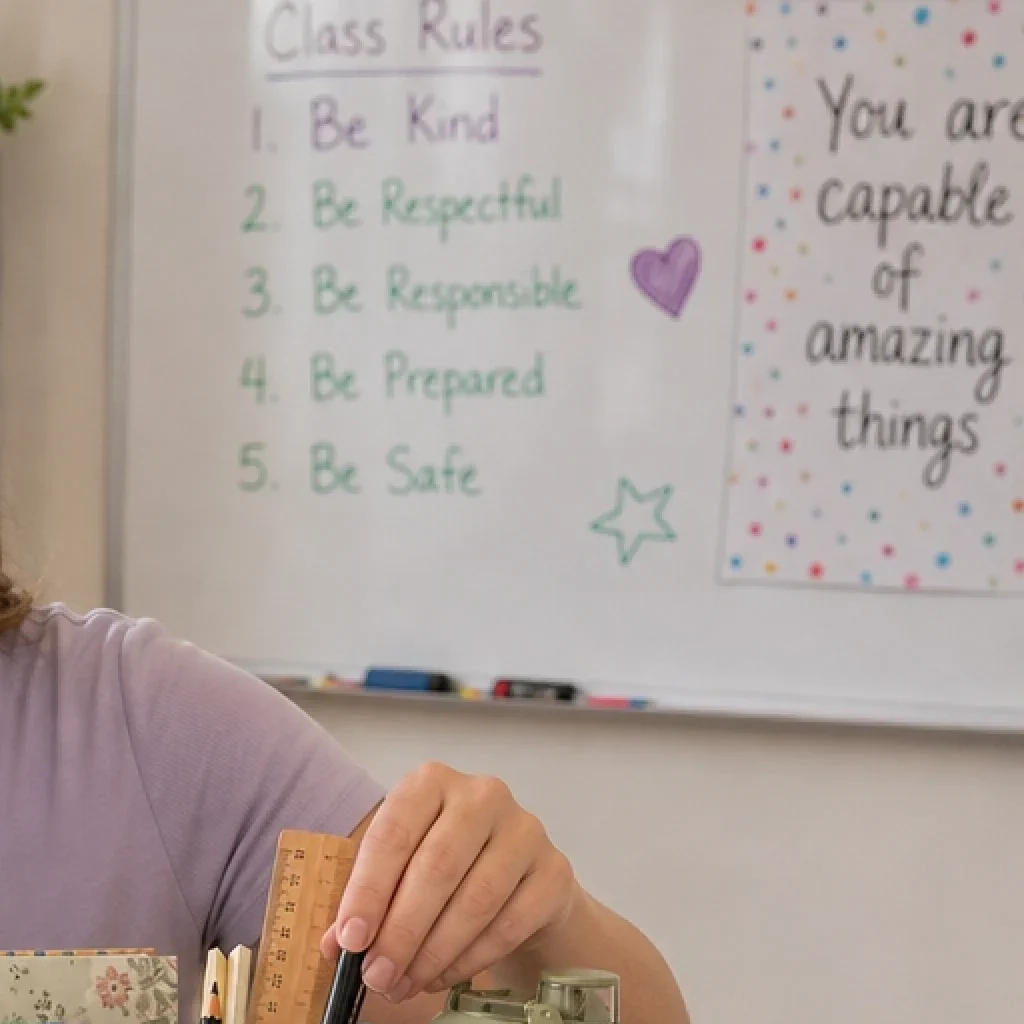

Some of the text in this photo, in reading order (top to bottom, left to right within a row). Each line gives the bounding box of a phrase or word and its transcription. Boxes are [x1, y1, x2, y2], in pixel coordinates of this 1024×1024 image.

[265, 0, 544, 61] Class Rules
[250, 93, 499, 152] 1. Be Kind
[817, 74, 914, 154] You
[240, 173, 563, 243] 2. Be Respectful
[818, 160, 1014, 248] capable
[240, 263, 582, 330] 3. Be Responsible
[872, 242, 925, 312] of
[240, 350, 546, 415] 4. Be Prepared
[806, 320, 1013, 404] amazing
[237, 442, 481, 495] 5. Be Safe
[832, 388, 980, 489] things
